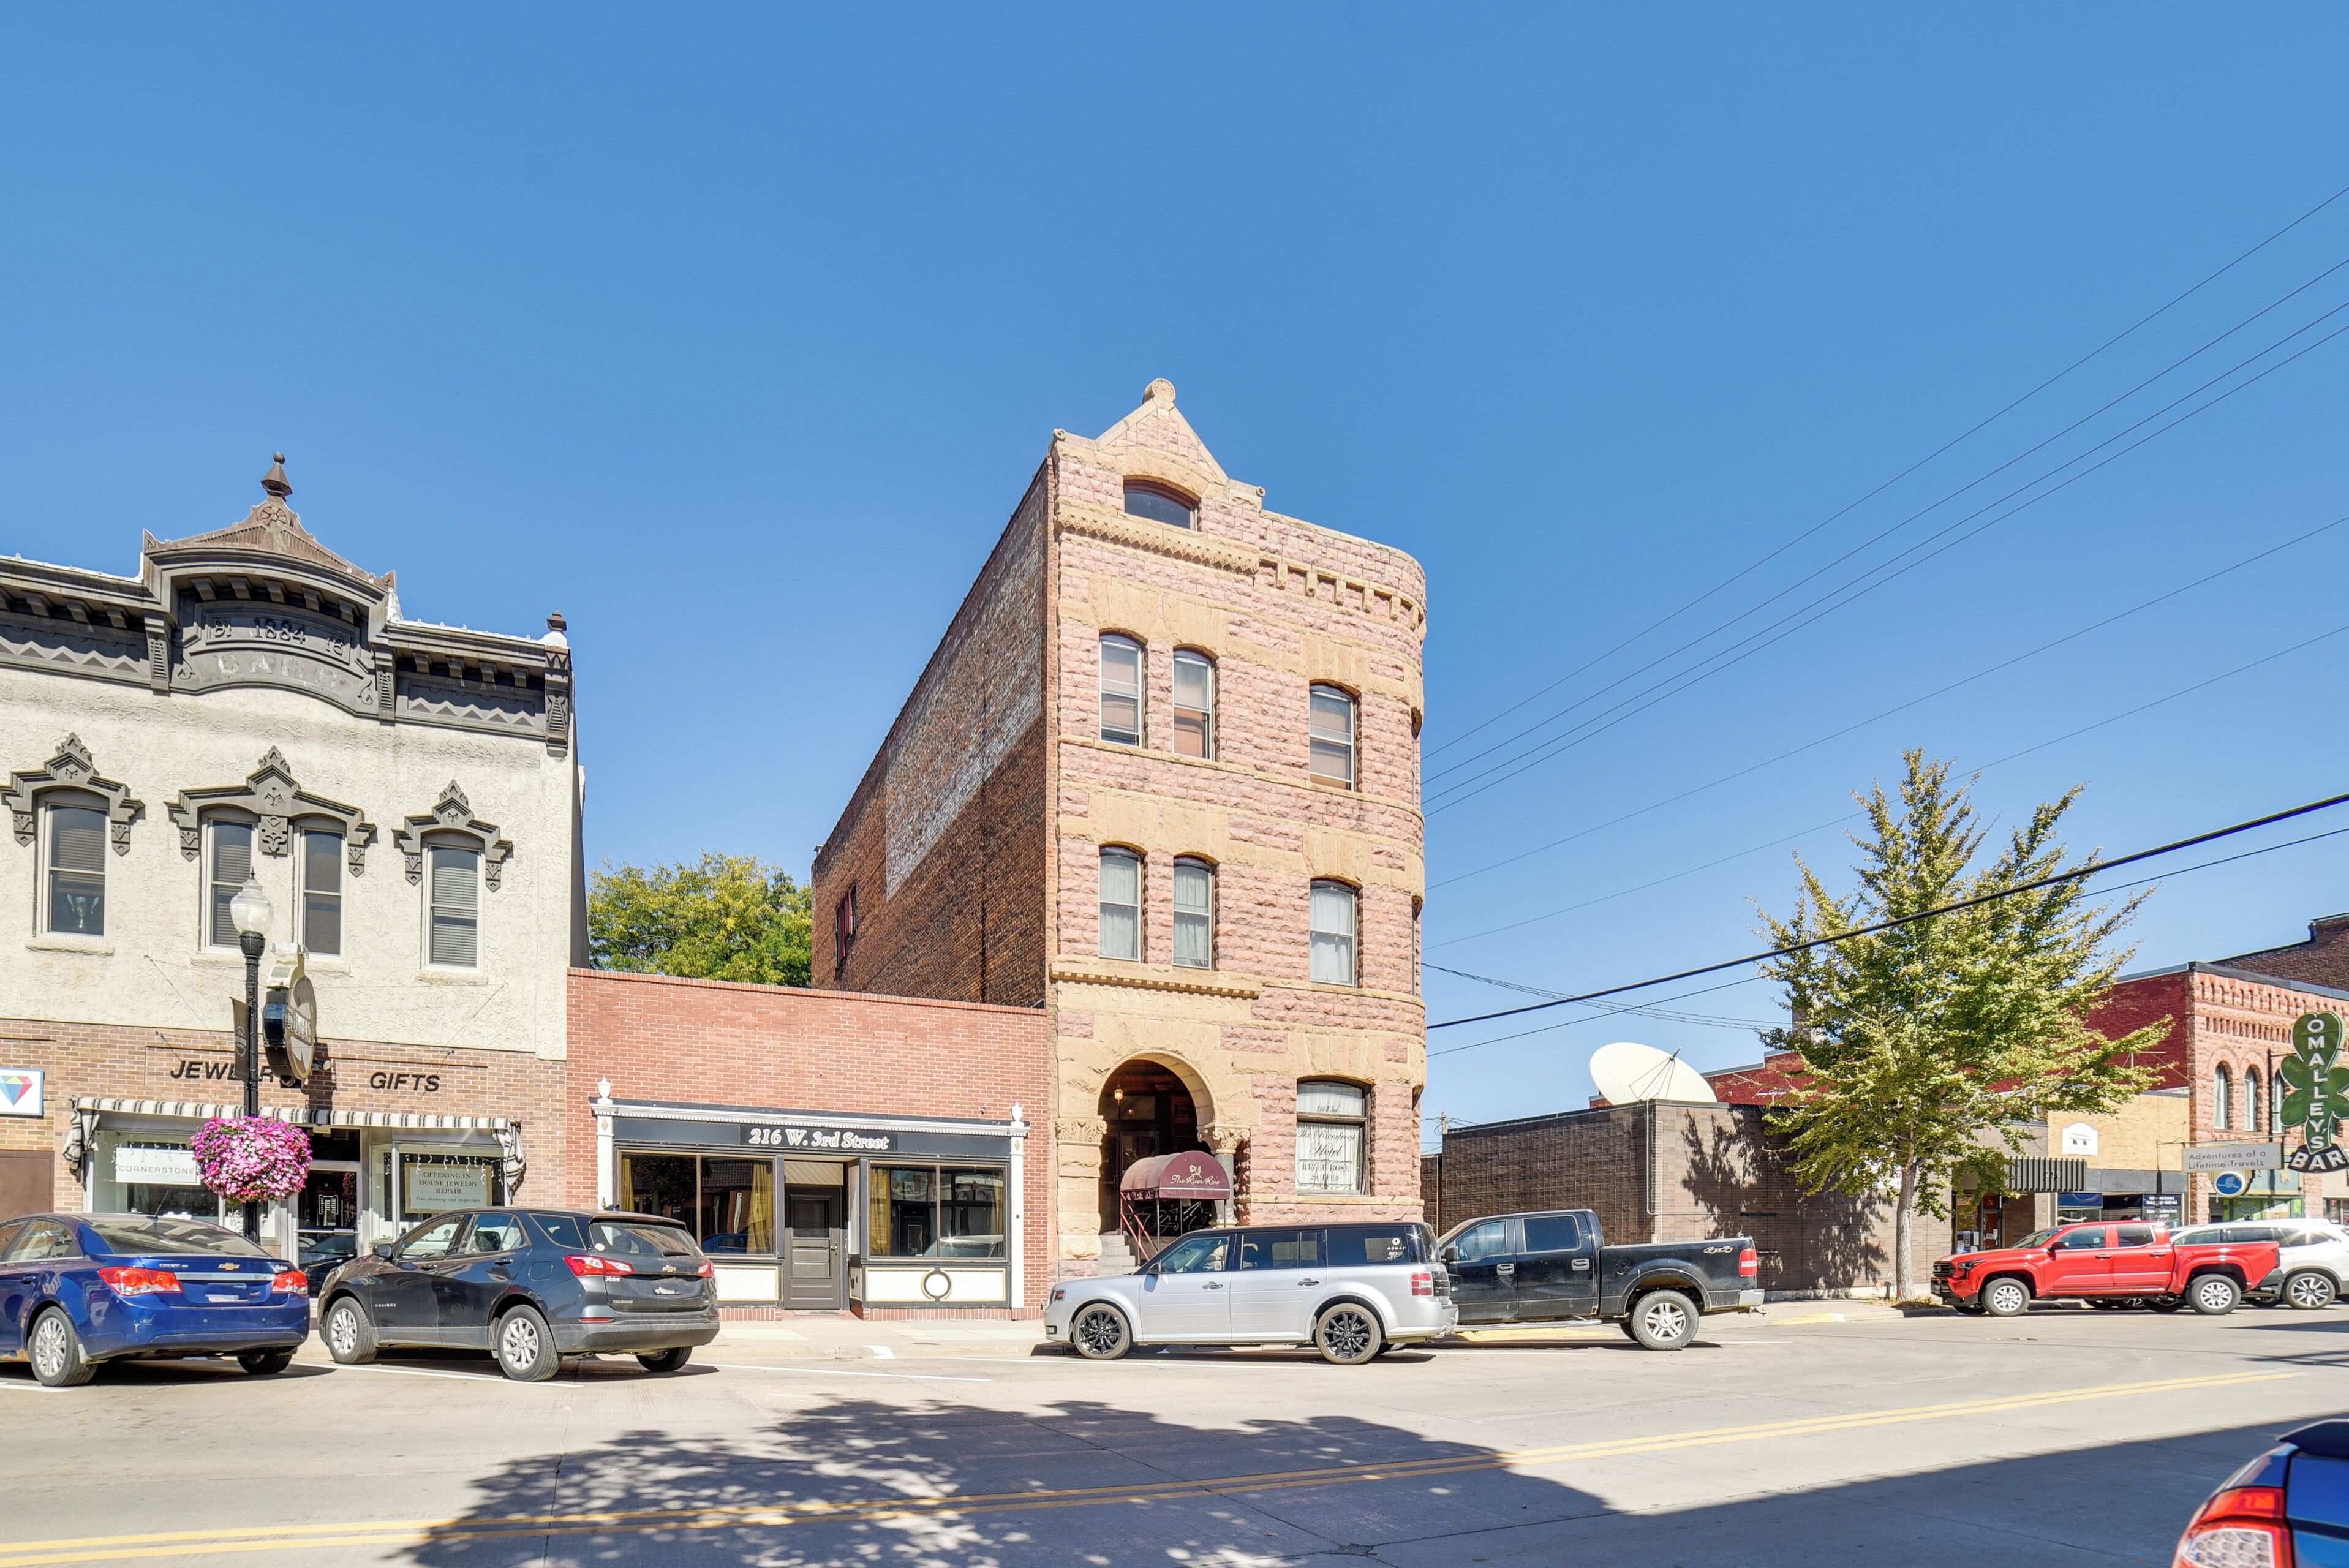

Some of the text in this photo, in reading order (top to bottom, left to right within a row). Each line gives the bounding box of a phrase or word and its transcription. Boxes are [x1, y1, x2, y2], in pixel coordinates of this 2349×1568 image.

[253, 617, 306, 643] 1884
[369, 1071, 440, 1091] GIFTS
[749, 1128, 889, 1150] 216 W. 3rd Street
[1330, 1164, 1350, 1172] ROSE
[2290, 1150, 2346, 1169] BAR
[119, 1165, 194, 1174] CORNERSTONE
[1170, 1175, 1221, 1186] The River Rose
